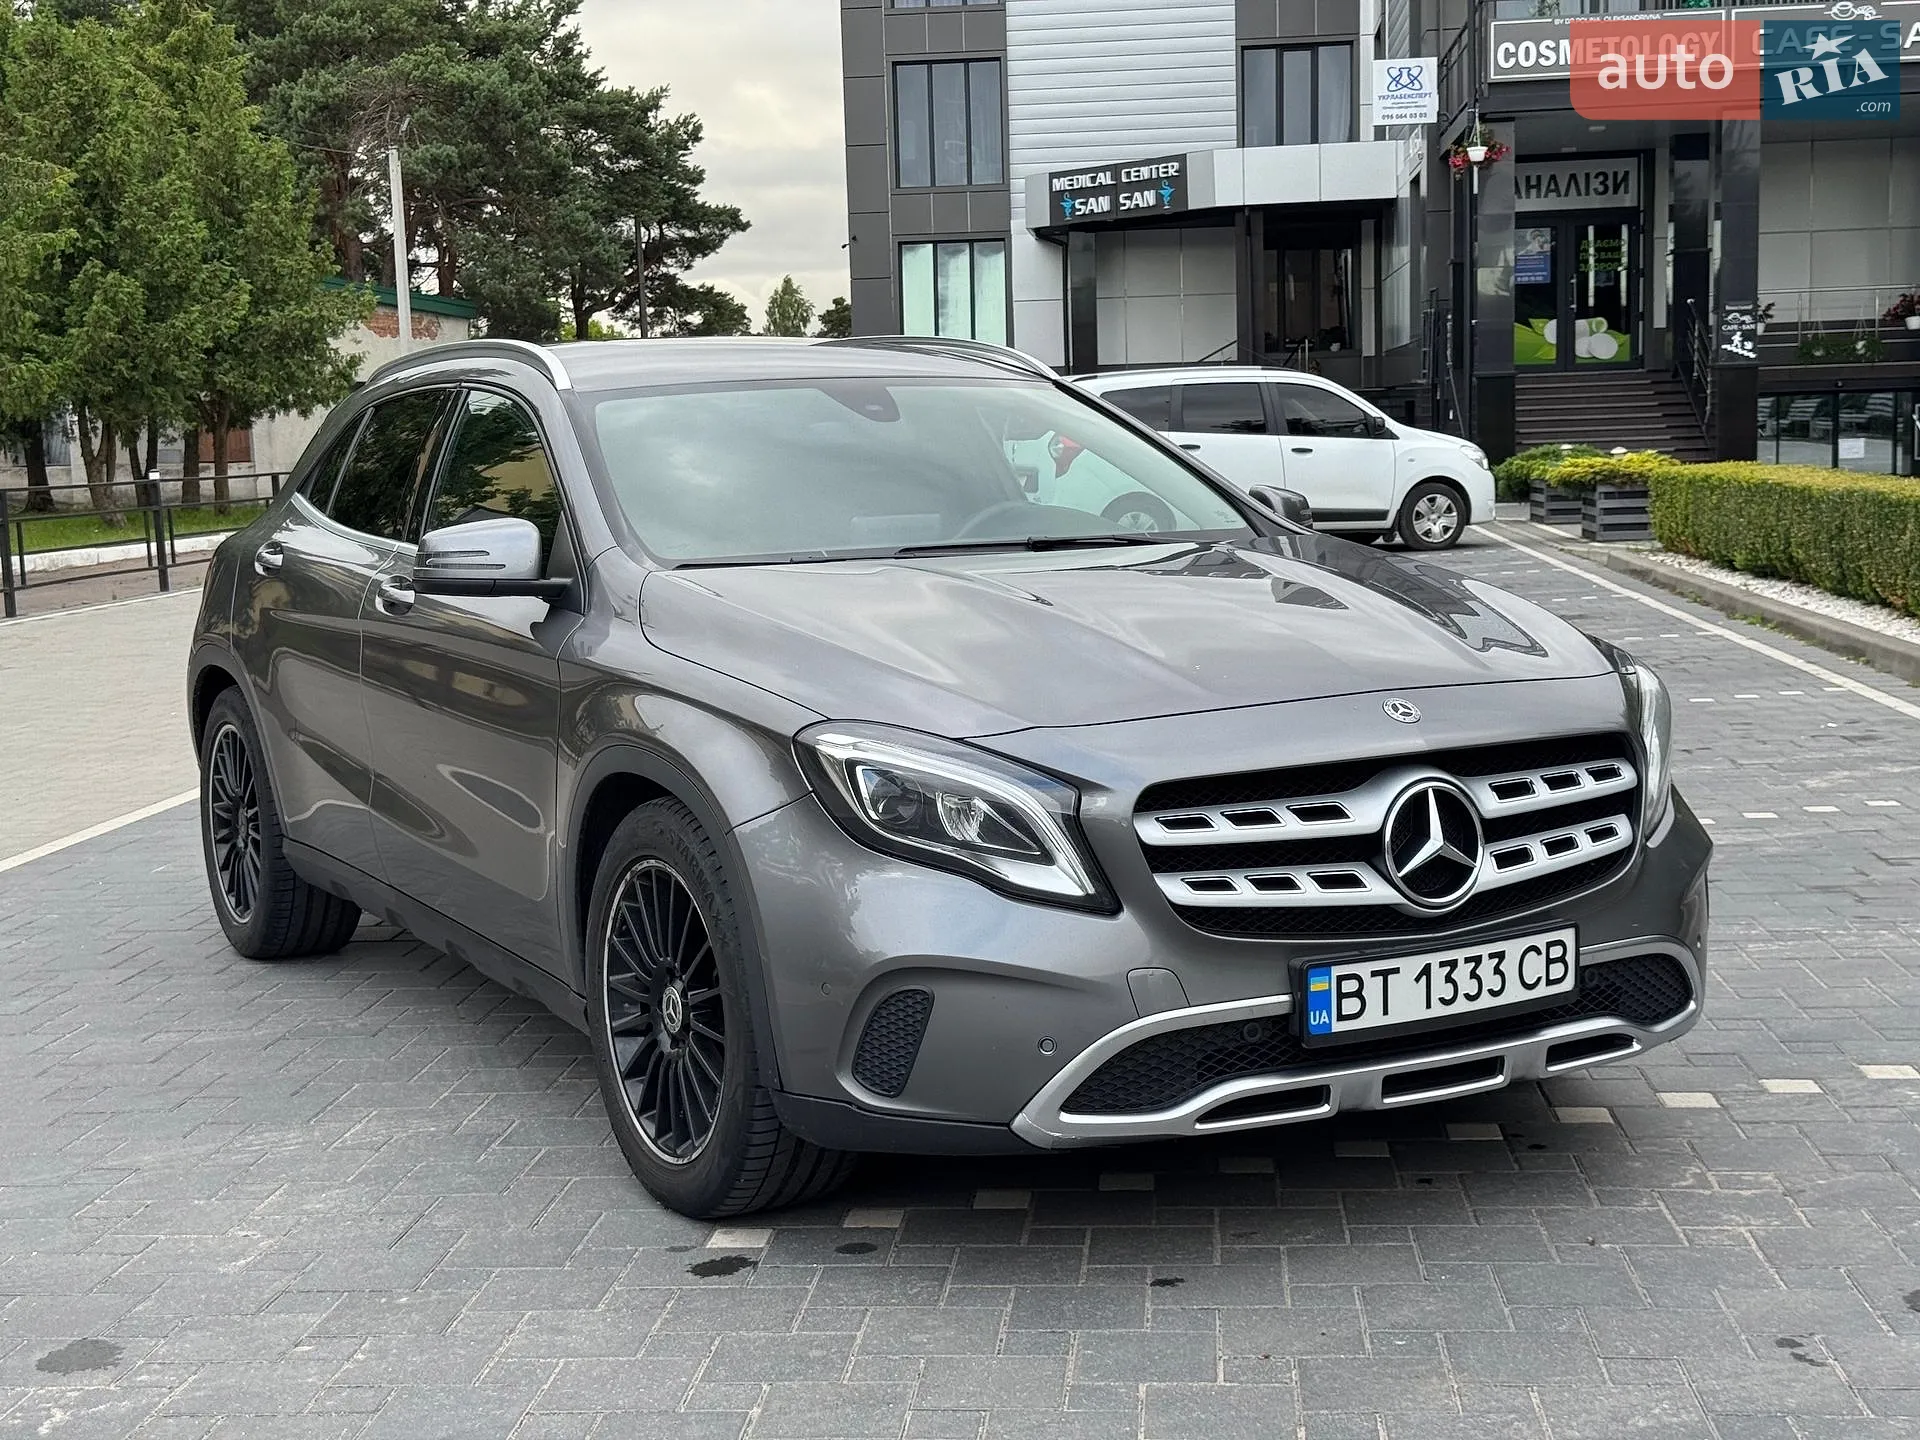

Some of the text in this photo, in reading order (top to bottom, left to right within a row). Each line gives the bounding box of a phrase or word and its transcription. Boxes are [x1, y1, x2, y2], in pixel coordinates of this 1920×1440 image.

[1497, 31, 1720, 69] COSMETOLOGY
[1052, 162, 1180, 192] MEDICAL CENTER
[1075, 189, 1157, 216] SAN SAN
[1336, 938, 1569, 1022] BT 1333 CB
[1310, 1009, 1330, 1026] UA
